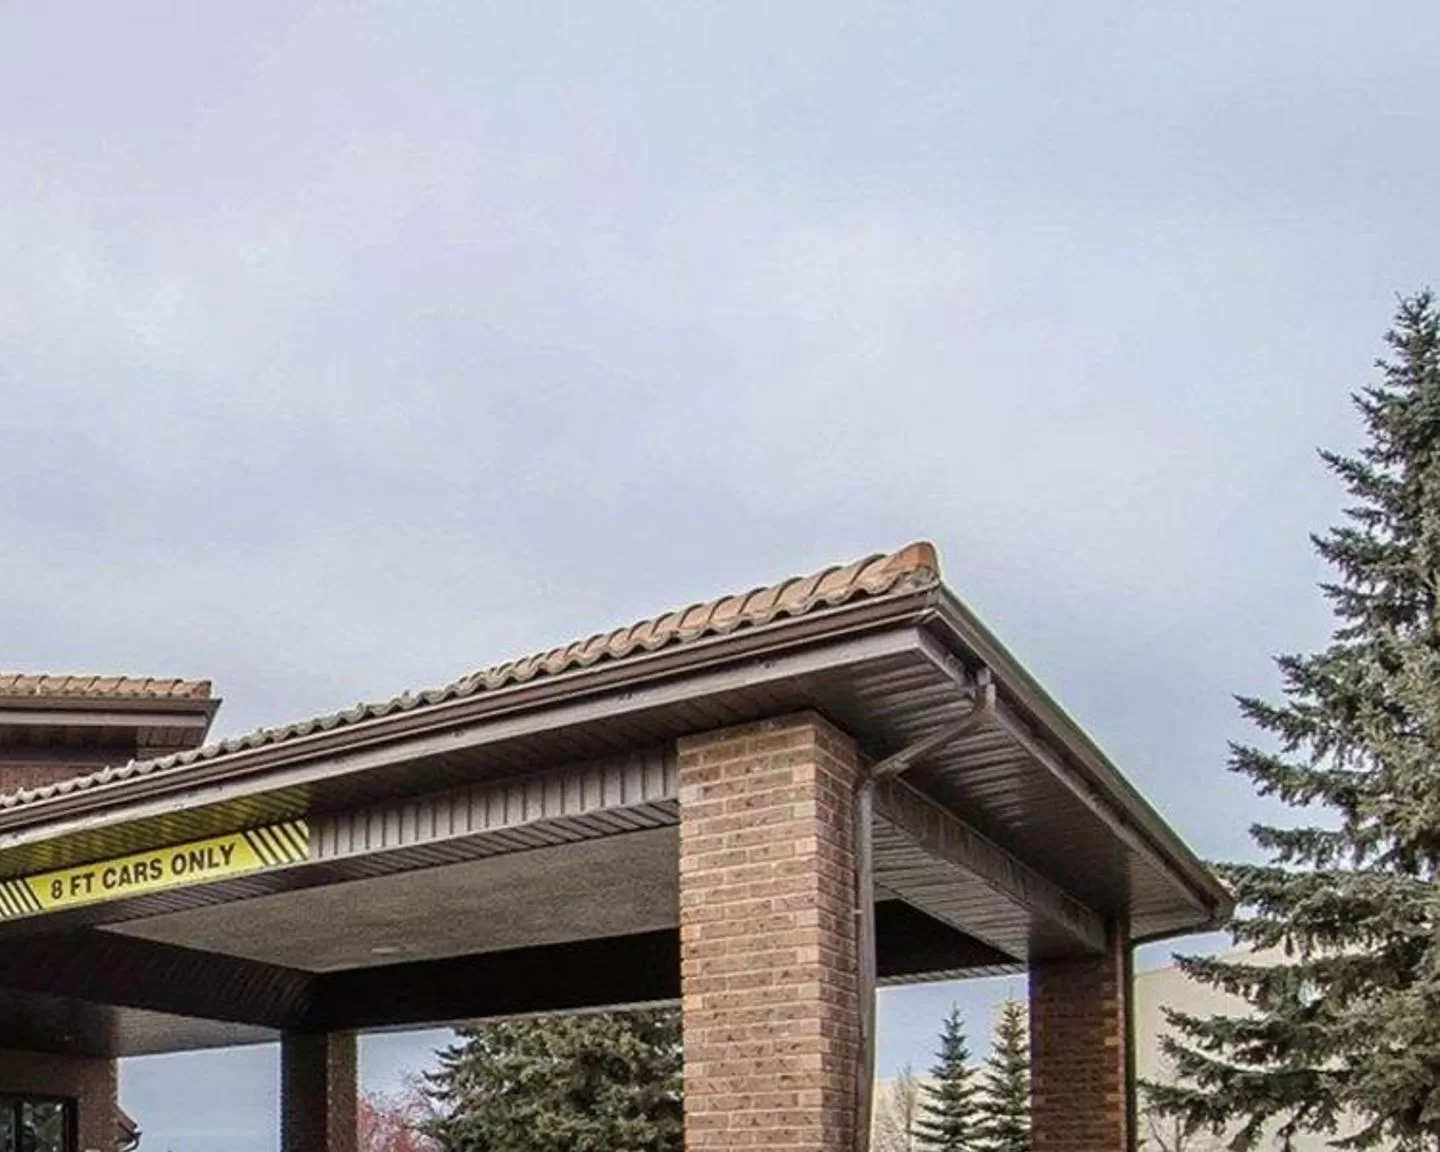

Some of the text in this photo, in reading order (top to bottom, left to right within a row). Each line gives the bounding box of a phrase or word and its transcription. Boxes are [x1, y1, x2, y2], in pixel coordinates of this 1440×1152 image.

[50, 843, 236, 899] 8 FT CARS ONLY
